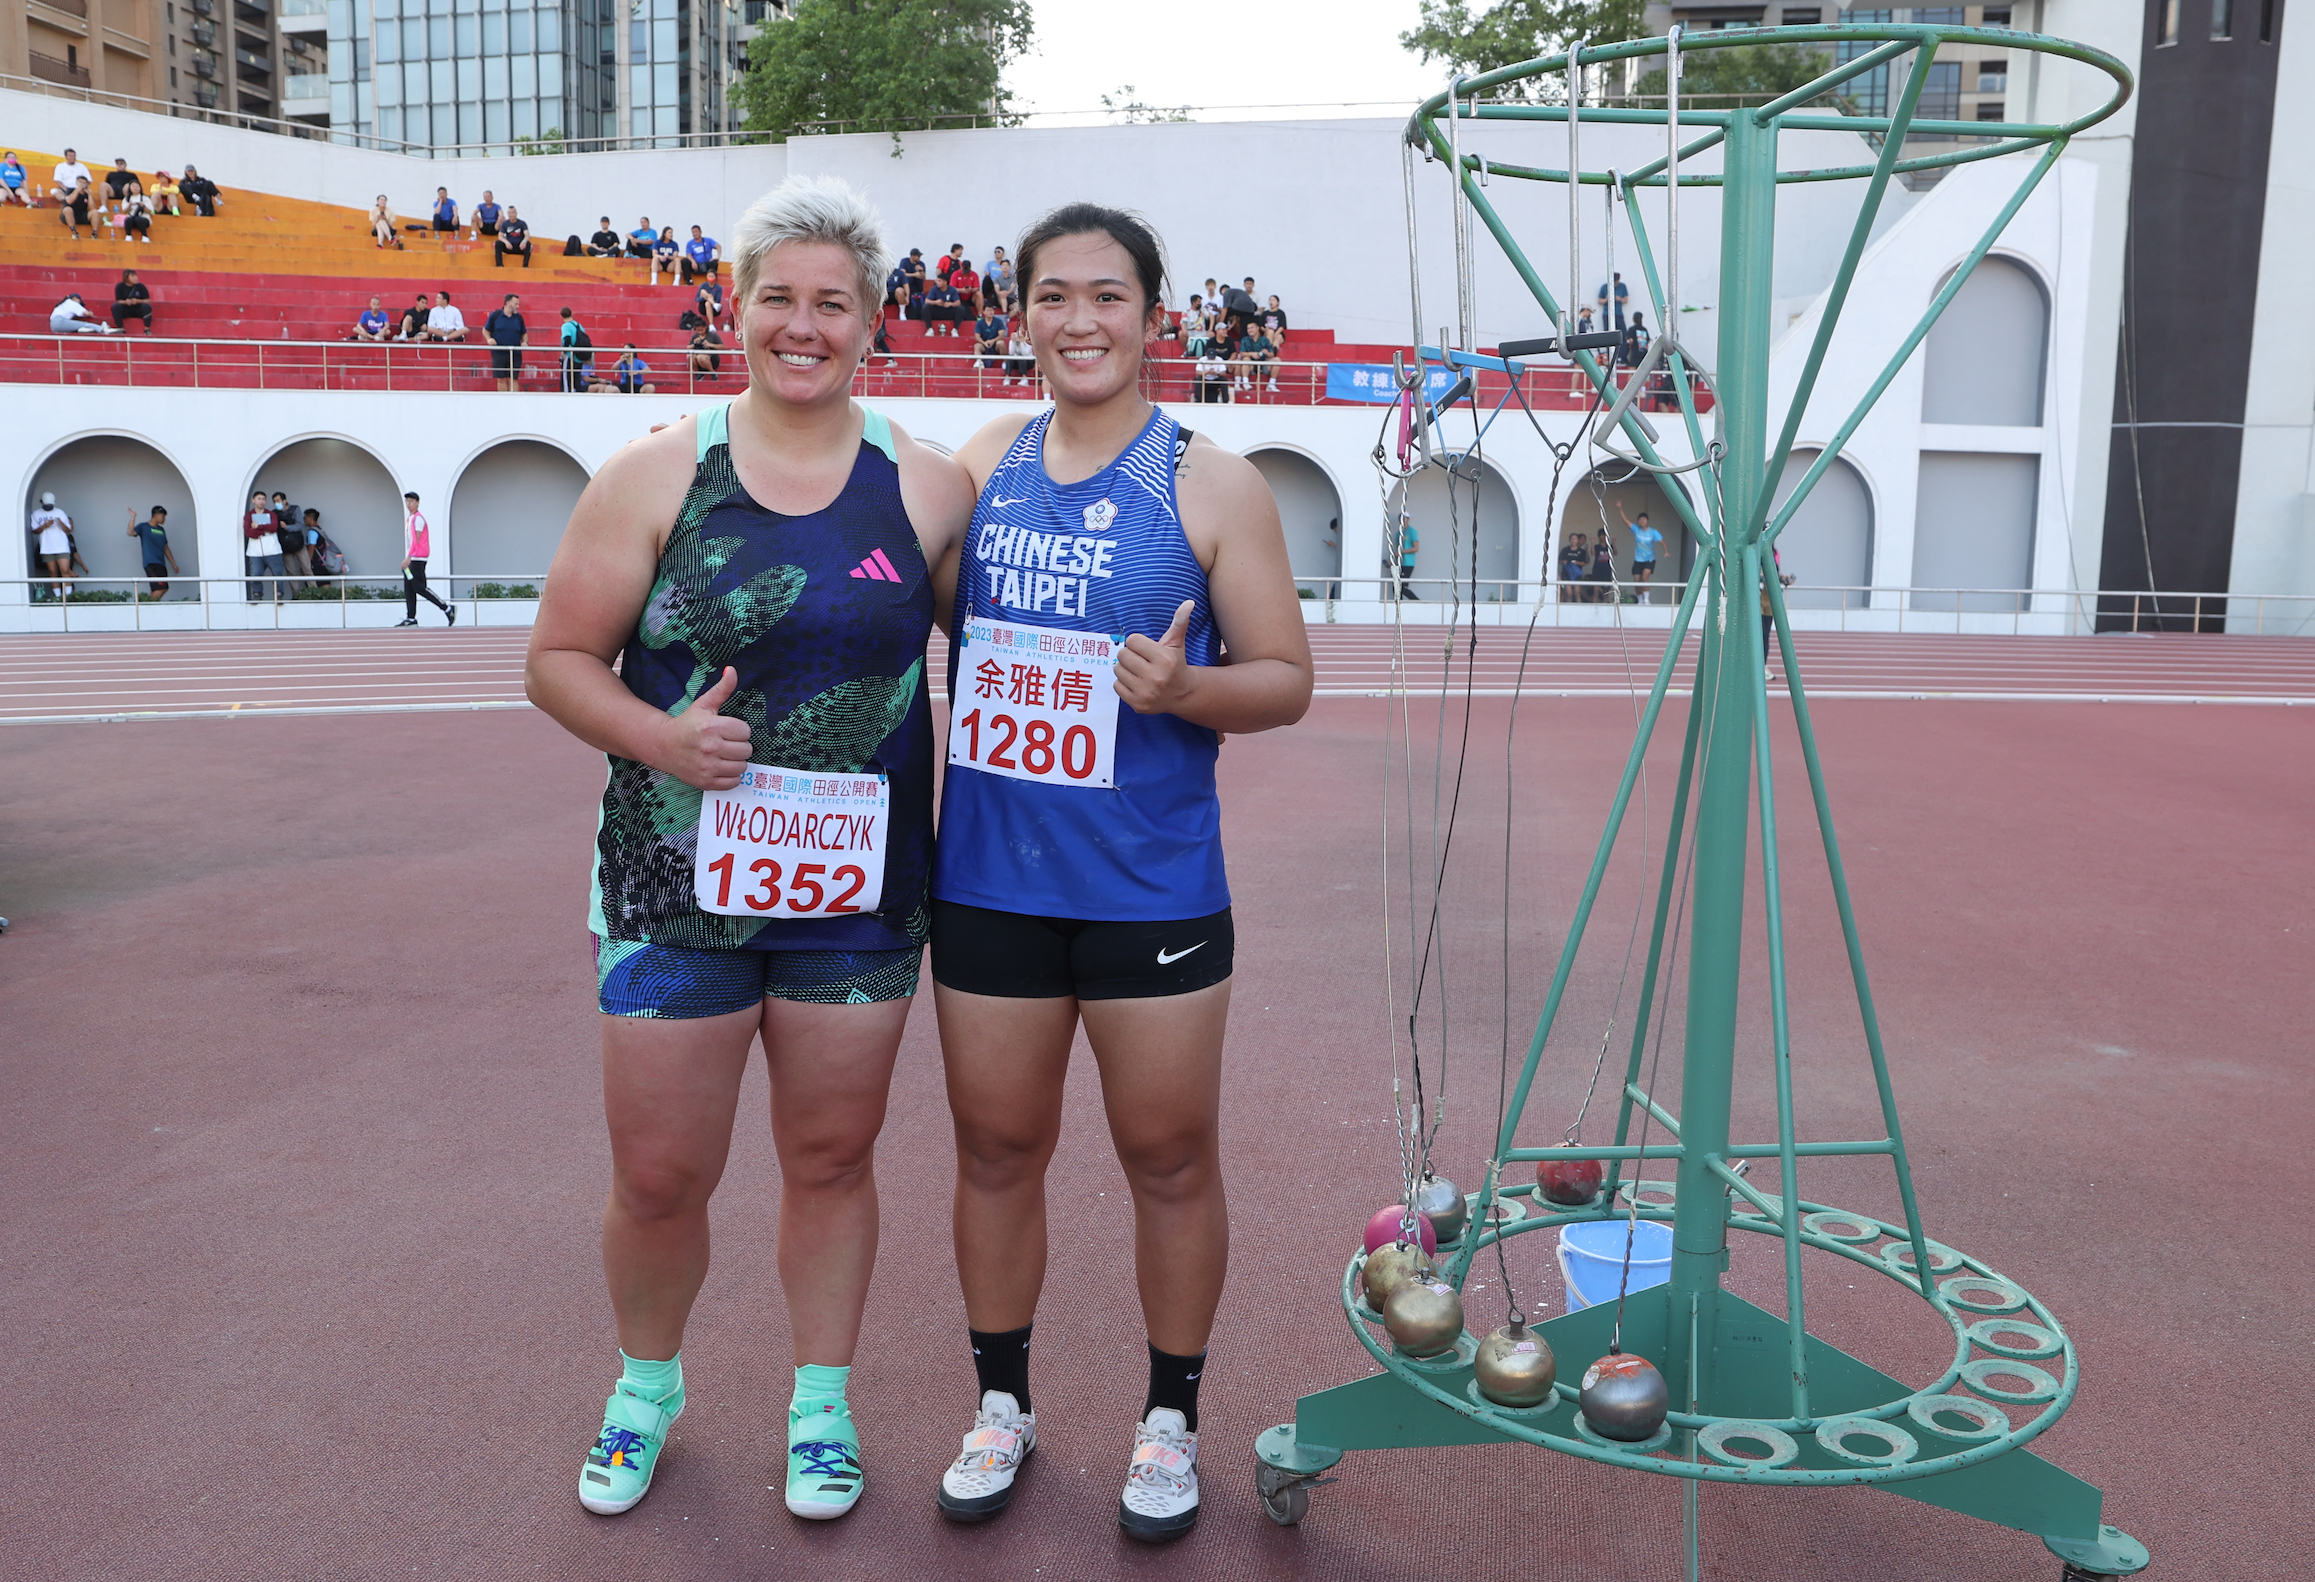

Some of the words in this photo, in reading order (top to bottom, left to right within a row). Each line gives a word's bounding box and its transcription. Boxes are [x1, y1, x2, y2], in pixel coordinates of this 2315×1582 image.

[1353, 370, 1447, 389] 教練席
[975, 524, 1118, 578] CHINESE
[985, 566, 1088, 617] TAIPEI
[970, 625, 1110, 658] 2023臺灣國際田徑公開賽
[991, 646, 1019, 656] TAIWAN
[1026, 651, 1075, 663] ATHLETICS
[1083, 658, 1109, 666] OPEN
[974, 658, 1093, 713] 余雅倩
[961, 708, 1097, 779] 1280
[739, 772, 878, 798] 23臺灣國際田徑公開賽
[752, 790, 789, 801] TAIWAN
[797, 797, 846, 805] ATHLETICS
[854, 798, 876, 806] OPEN
[715, 799, 876, 851] WŁODARCZYK
[708, 852, 866, 913] 1352
[971, 1429, 1018, 1450] NIKE
[1134, 1444, 1182, 1468] NIKE
